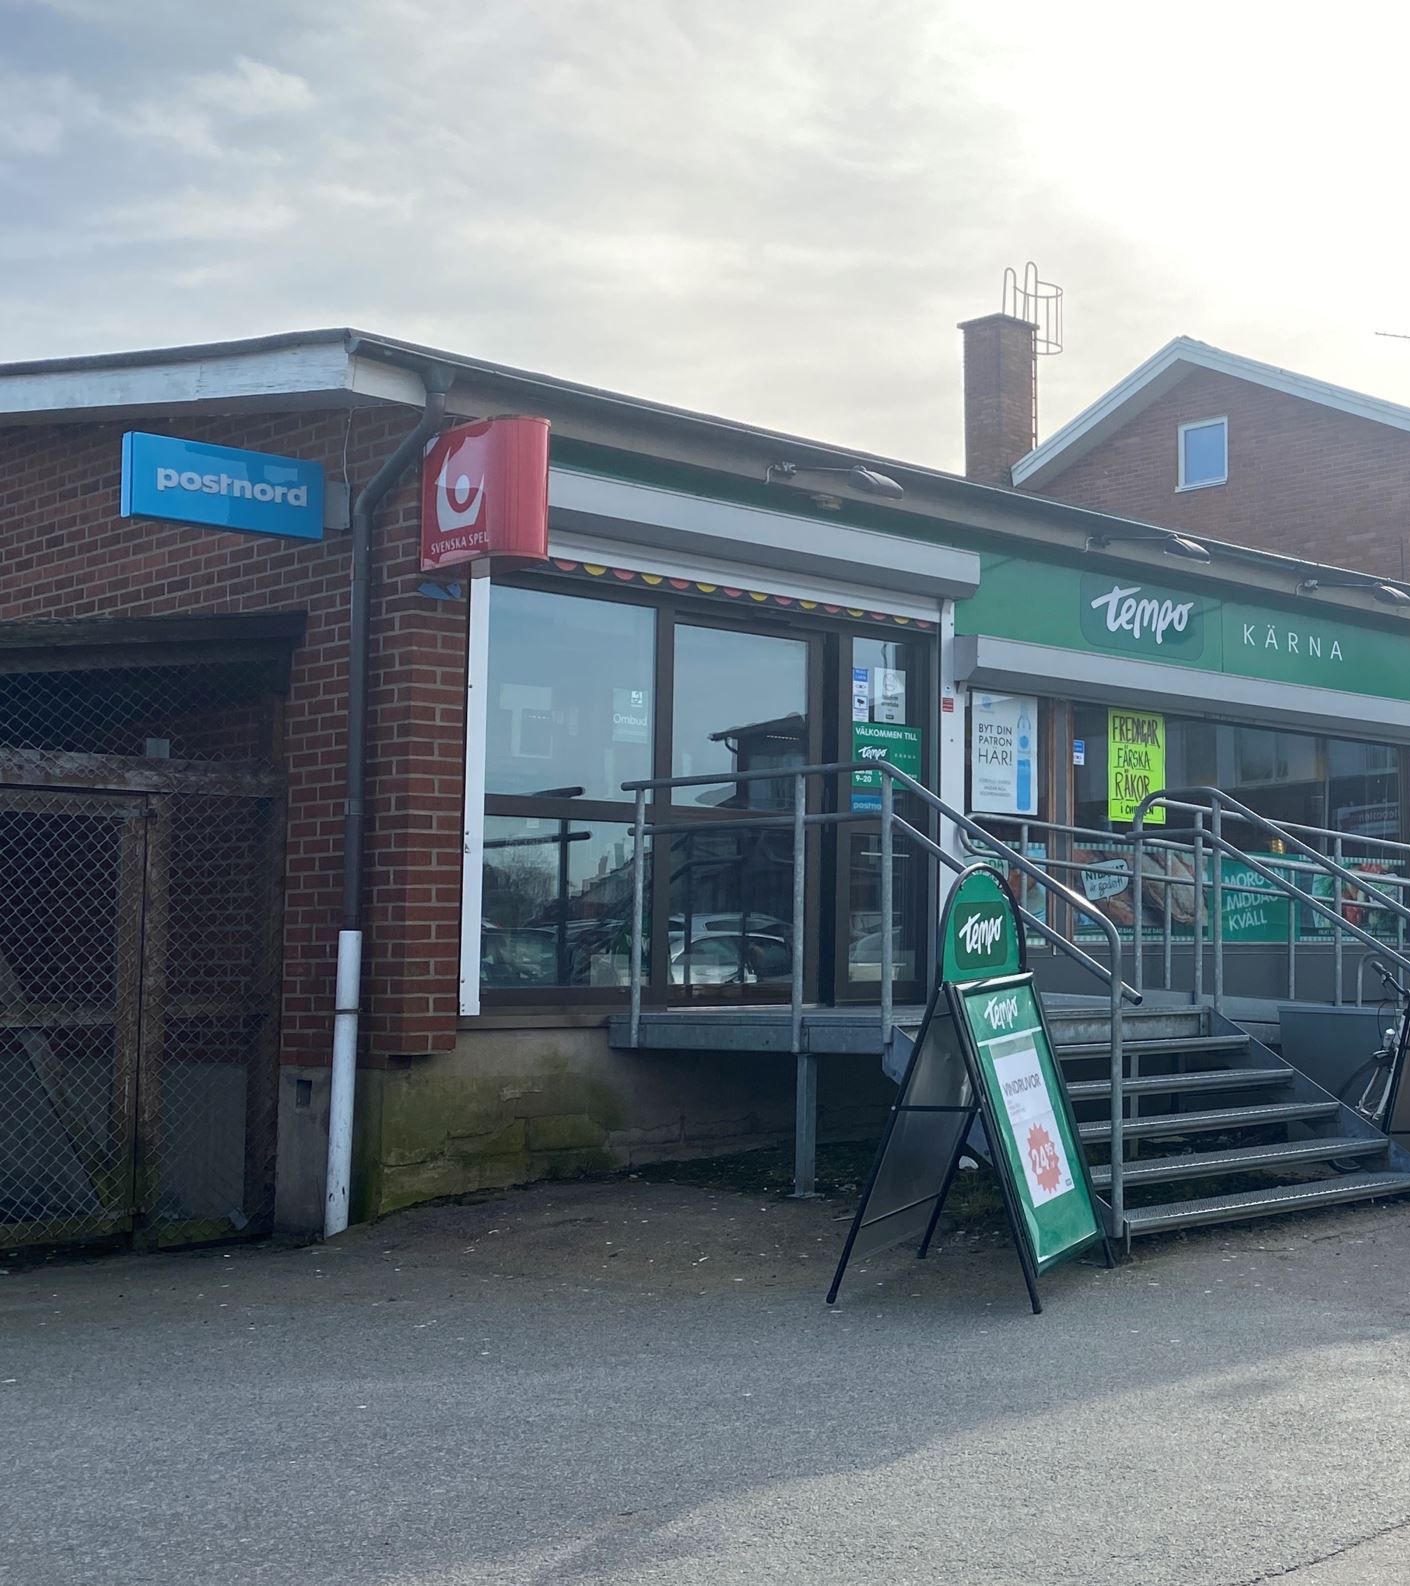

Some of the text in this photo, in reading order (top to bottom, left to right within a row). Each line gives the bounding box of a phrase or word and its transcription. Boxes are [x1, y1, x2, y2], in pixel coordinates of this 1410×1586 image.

[157, 467, 307, 507] postnord
[431, 531, 490, 555] SVENSKA SPEL
[1243, 623, 1343, 661] KÄRNA
[613, 713, 648, 726] Ombud
[978, 723, 1012, 735] BYT DIN
[855, 726, 918, 741] VÄLKOMMEN TILL
[978, 735, 1012, 747] PATRON
[1112, 715, 1160, 749] FREDAGAR
[978, 747, 1013, 767] HÄR!
[1116, 745, 1151, 770] FÄRSKA
[1115, 769, 1150, 803] RÄKOR
[1229, 908, 1267, 932] KVÄLL
[1003, 1073, 1041, 1097] VINDRUVOR
